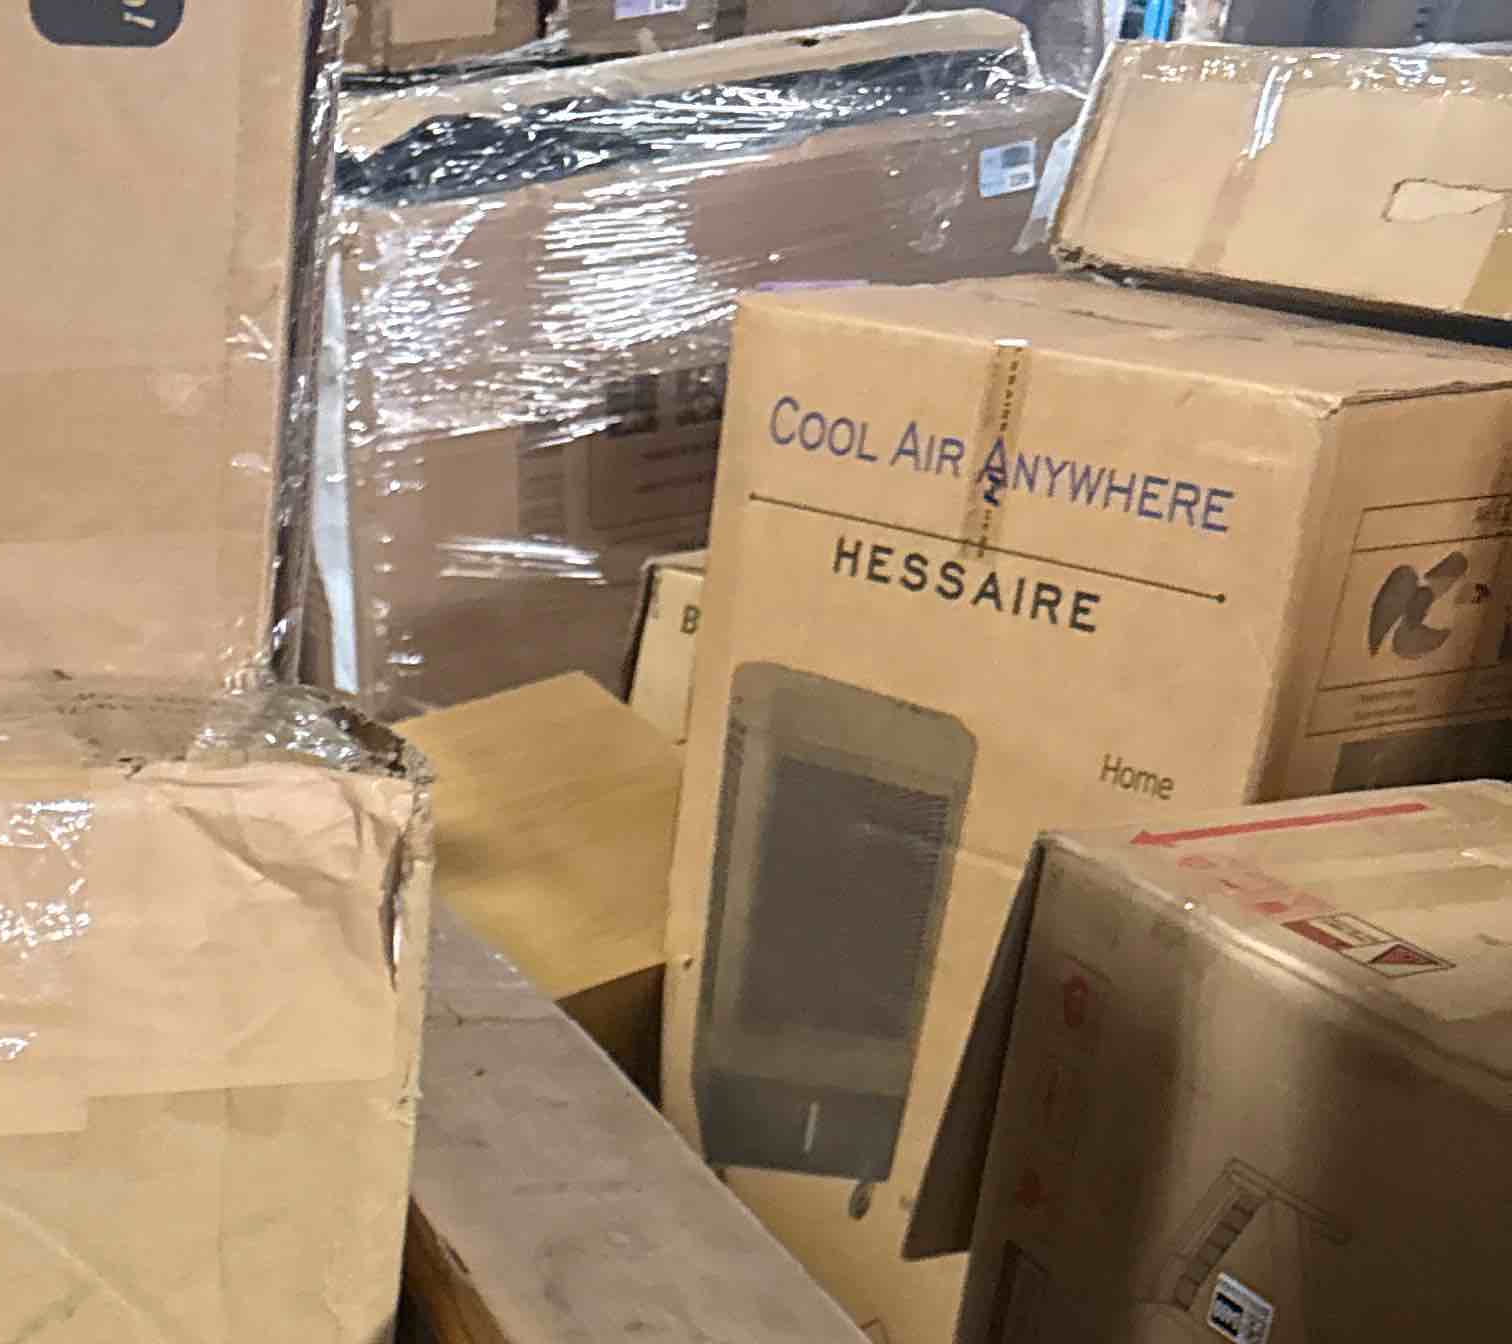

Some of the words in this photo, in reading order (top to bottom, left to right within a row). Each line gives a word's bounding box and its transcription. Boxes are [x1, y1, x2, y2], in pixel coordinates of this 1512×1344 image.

[769, 396, 879, 463] COOL
[890, 420, 966, 480] AIR
[976, 436, 1236, 534] ANYWHERE
[832, 535, 1101, 634] HESSAIRE
[1098, 751, 1176, 801] Home
